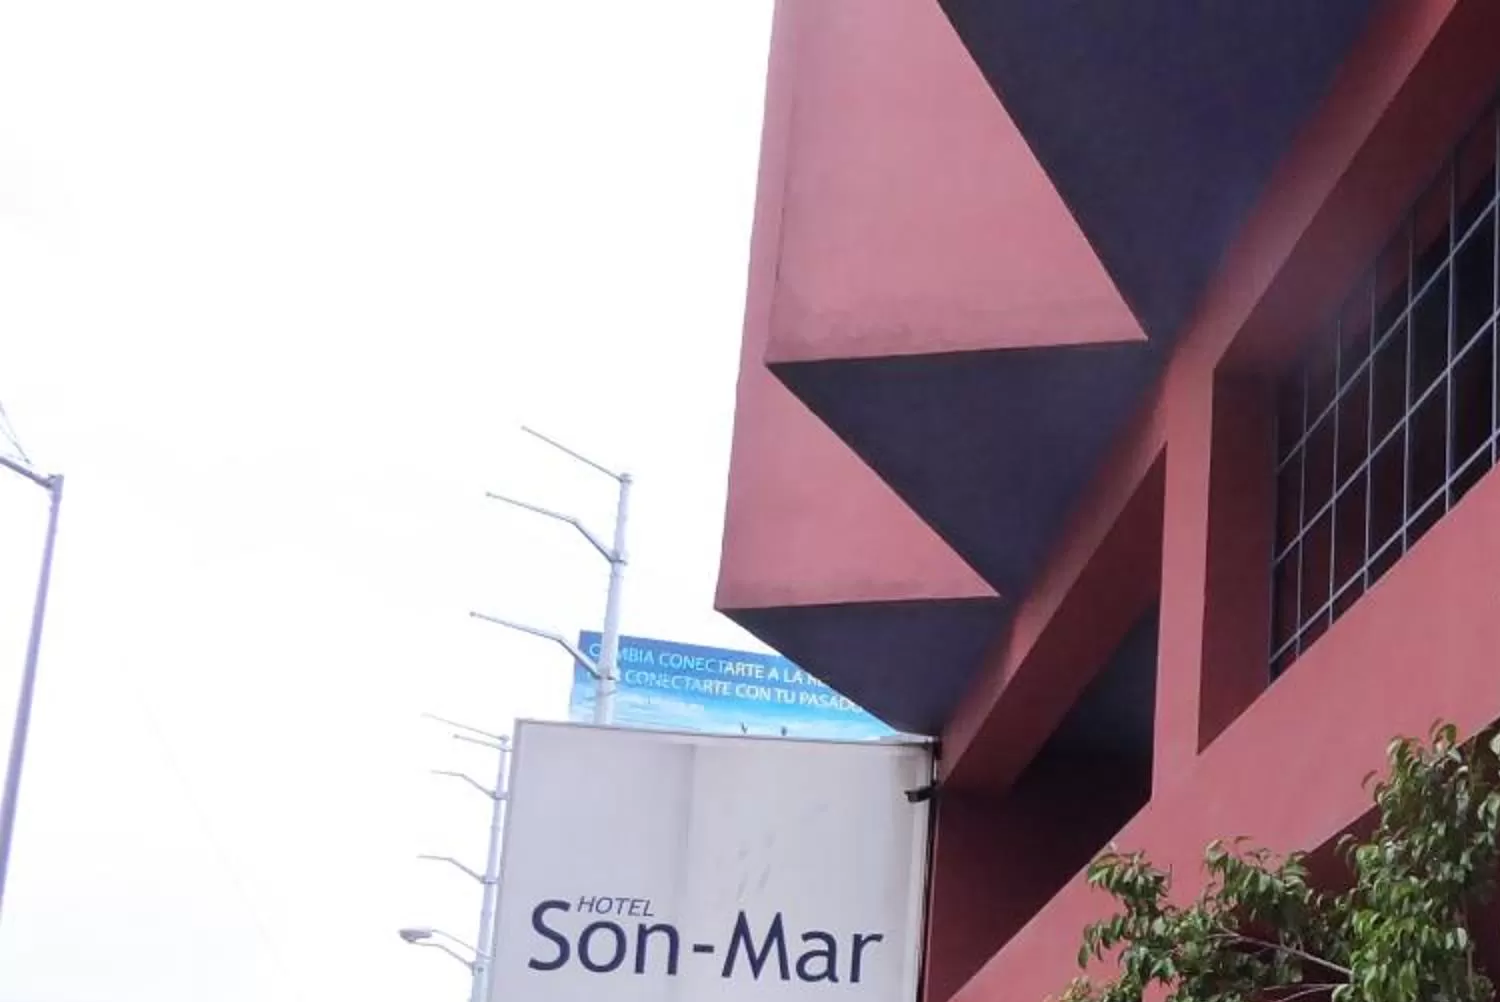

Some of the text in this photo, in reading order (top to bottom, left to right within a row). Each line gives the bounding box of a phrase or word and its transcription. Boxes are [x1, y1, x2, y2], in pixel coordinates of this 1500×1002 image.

[588, 643, 655, 665] CMBIA
[659, 652, 765, 679] CONECTARTE
[767, 669, 779, 681] A
[784, 668, 803, 683] LA
[625, 669, 732, 697] CONECTARTE
[736, 683, 770, 701] CON
[774, 688, 796, 704] TU
[577, 895, 655, 917] HOTEL
[528, 899, 884, 983] Son-Mar
